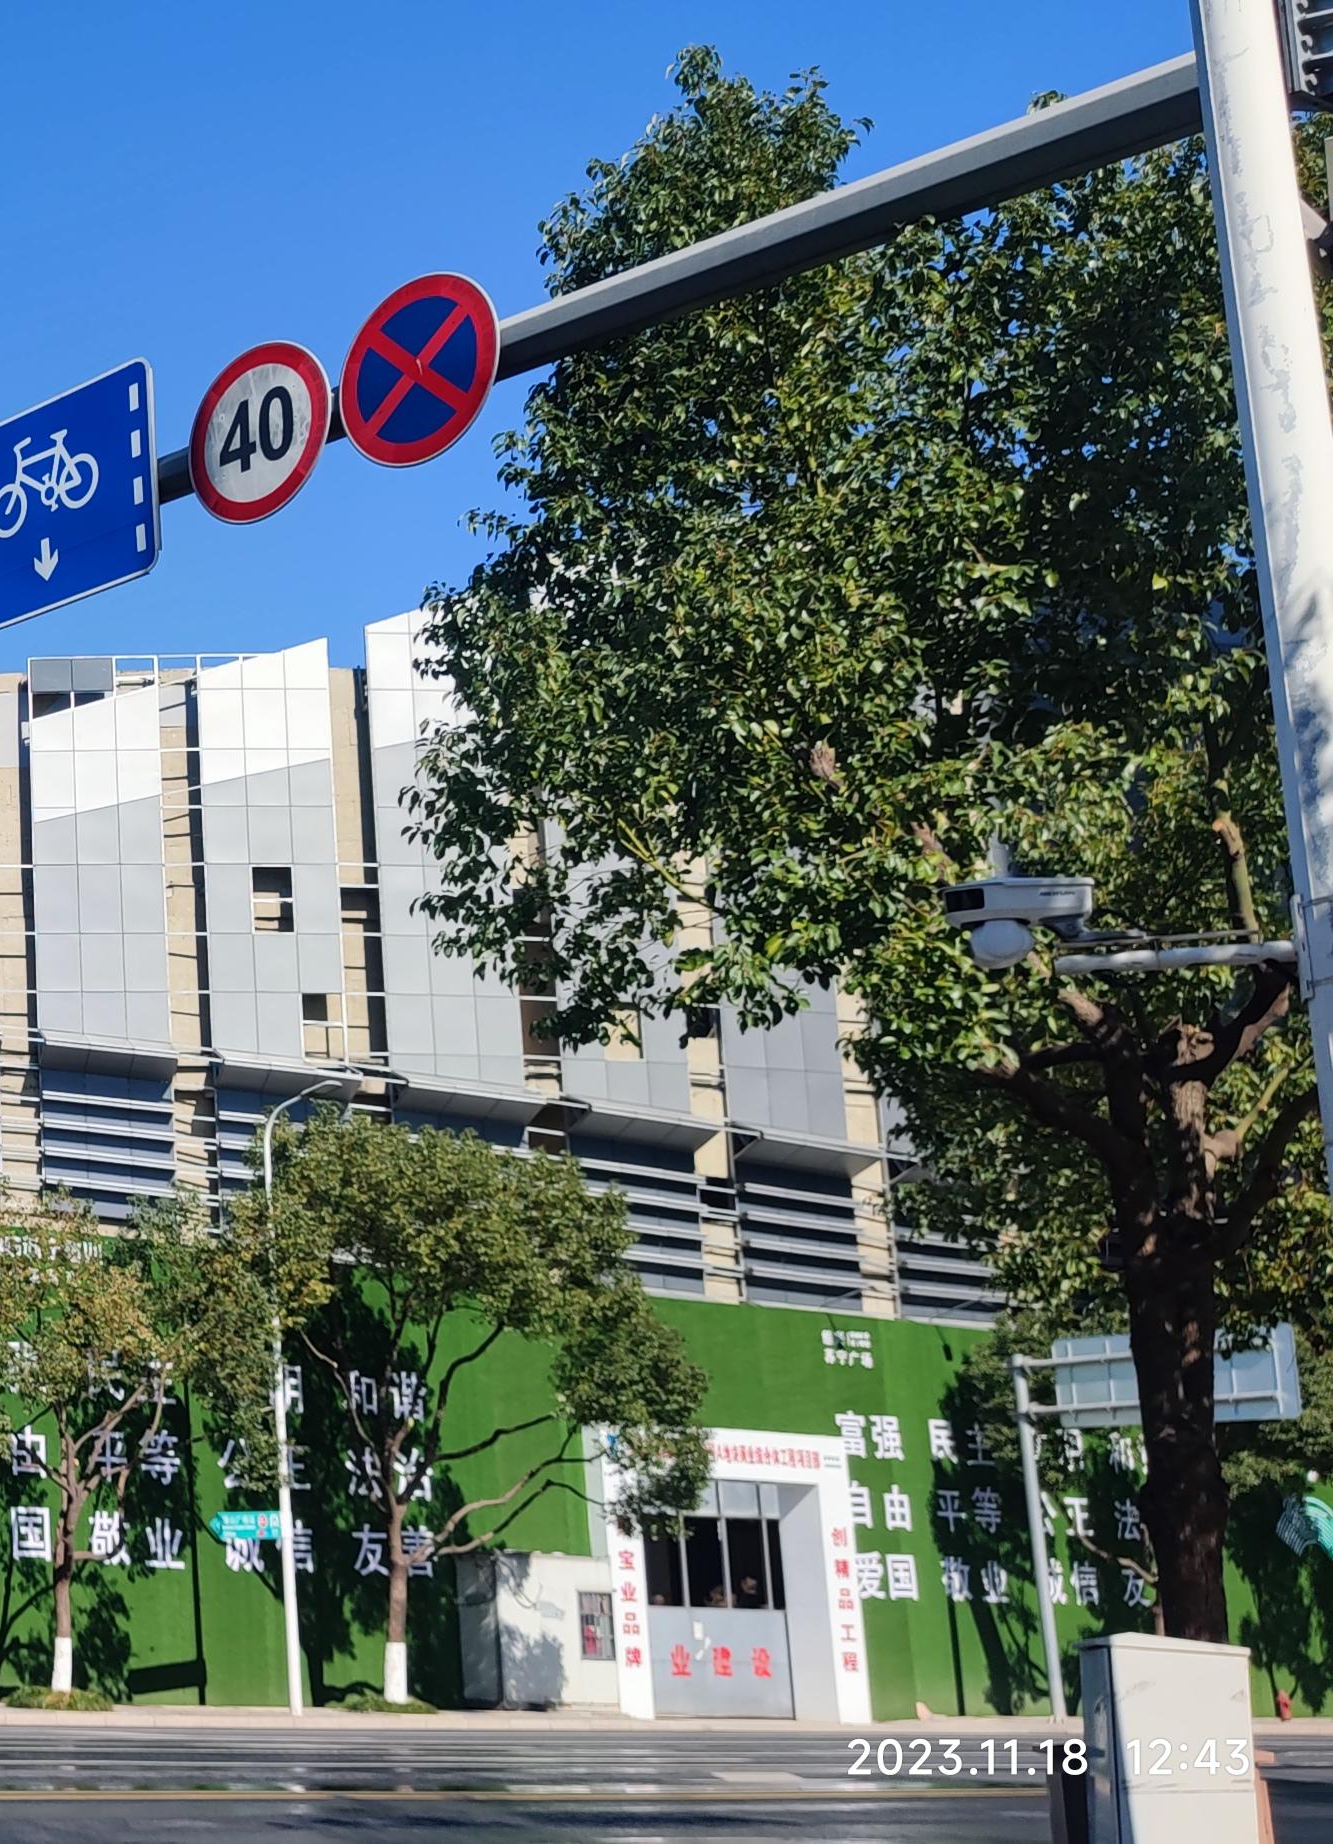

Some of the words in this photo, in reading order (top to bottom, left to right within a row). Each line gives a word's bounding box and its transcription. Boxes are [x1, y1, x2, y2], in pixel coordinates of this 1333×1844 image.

[219, 385, 294, 473] 40
[835, 1410, 905, 1462] 富强
[928, 1418, 996, 1467] 民主
[848, 1480, 913, 1532] 自由
[937, 1486, 1003, 1534] 平等
[87, 1509, 186, 1571] 敬业
[855, 1552, 920, 1602] 爱国
[940, 1556, 1010, 1604] 敬业
